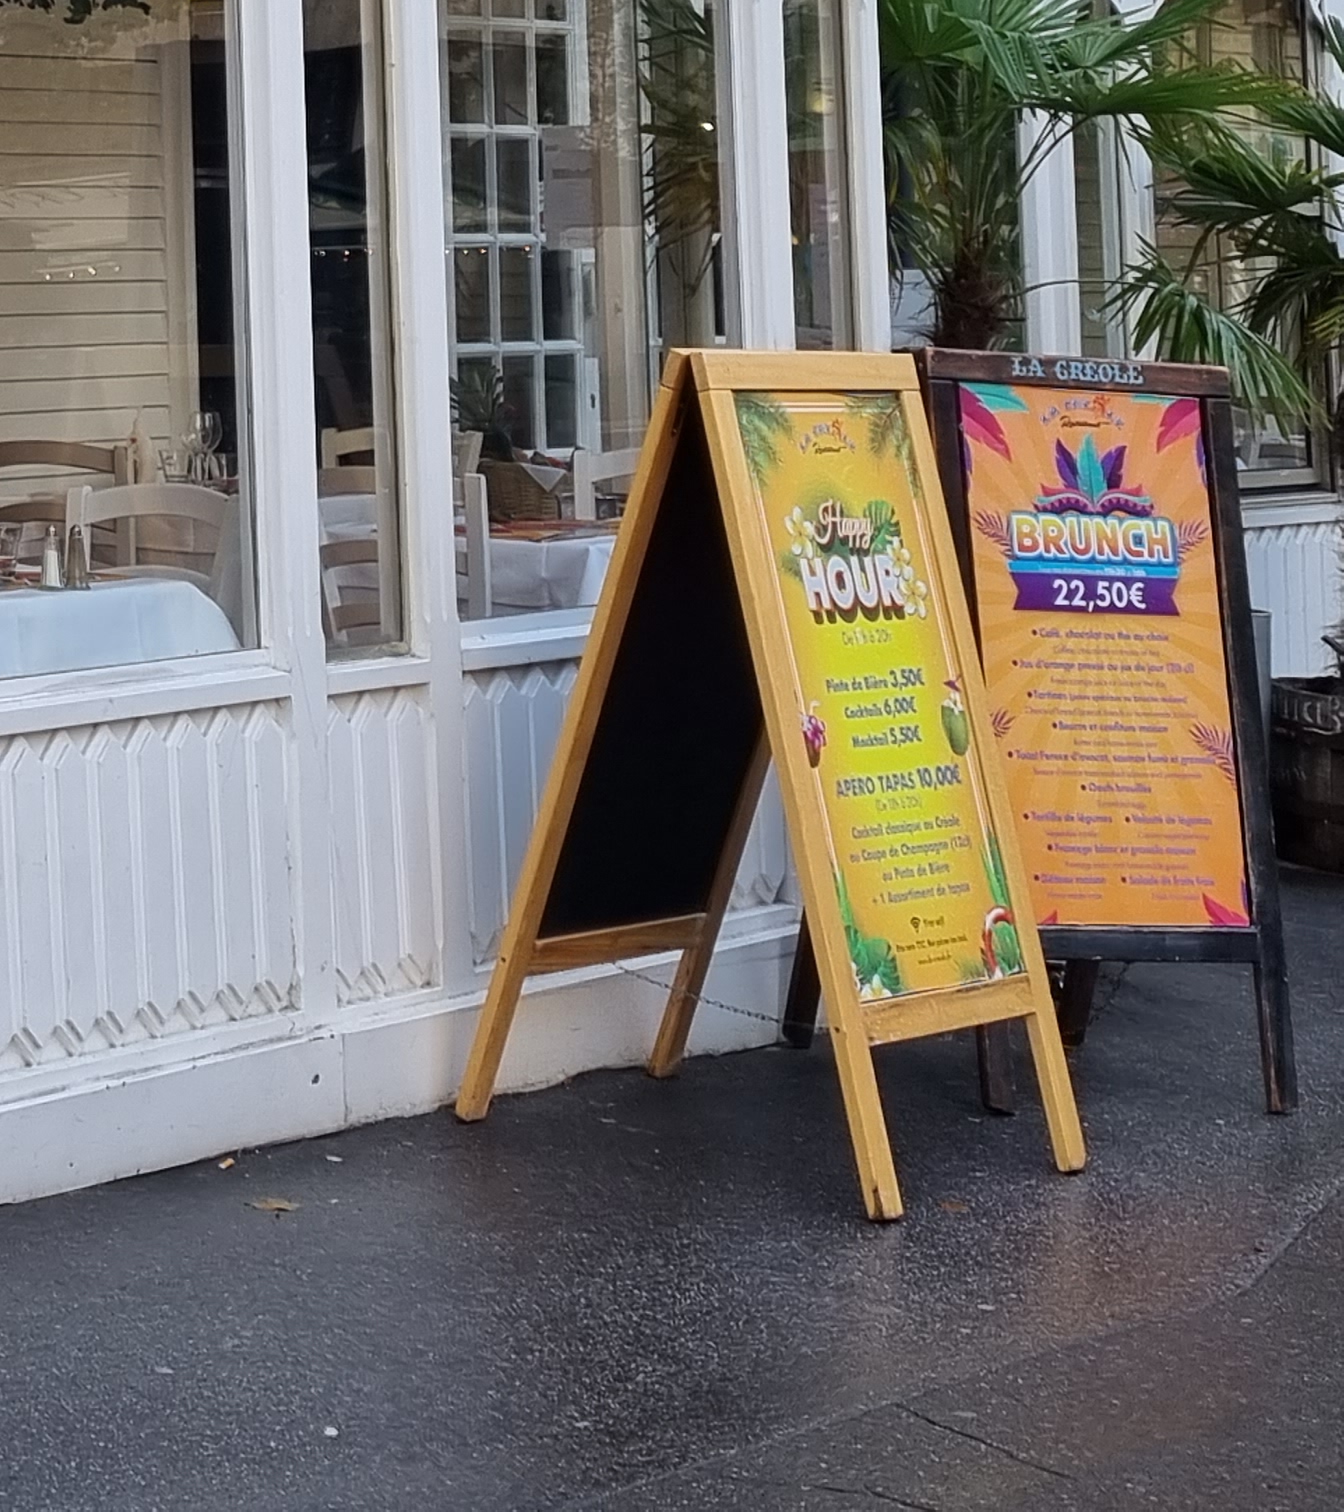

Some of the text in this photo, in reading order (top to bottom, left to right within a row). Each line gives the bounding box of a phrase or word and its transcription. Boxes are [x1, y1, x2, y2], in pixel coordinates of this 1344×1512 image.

[1011, 357, 1046, 377] LA
[812, 499, 873, 549] Happy
[1011, 514, 1174, 563] BRUNCH
[799, 554, 906, 614] HOUR
[1053, 578, 1147, 613] 22,50€
[826, 678, 849, 693] Pinte
[852, 677, 862, 691] de
[889, 668, 925, 692] 3,50€
[844, 696, 917, 719] Cocktails 6,00€
[889, 725, 922, 747] 5,50€
[877, 772, 917, 792] TAPAS
[916, 764, 961, 792] 10,00€
[900, 841, 949, 857] Champagne
